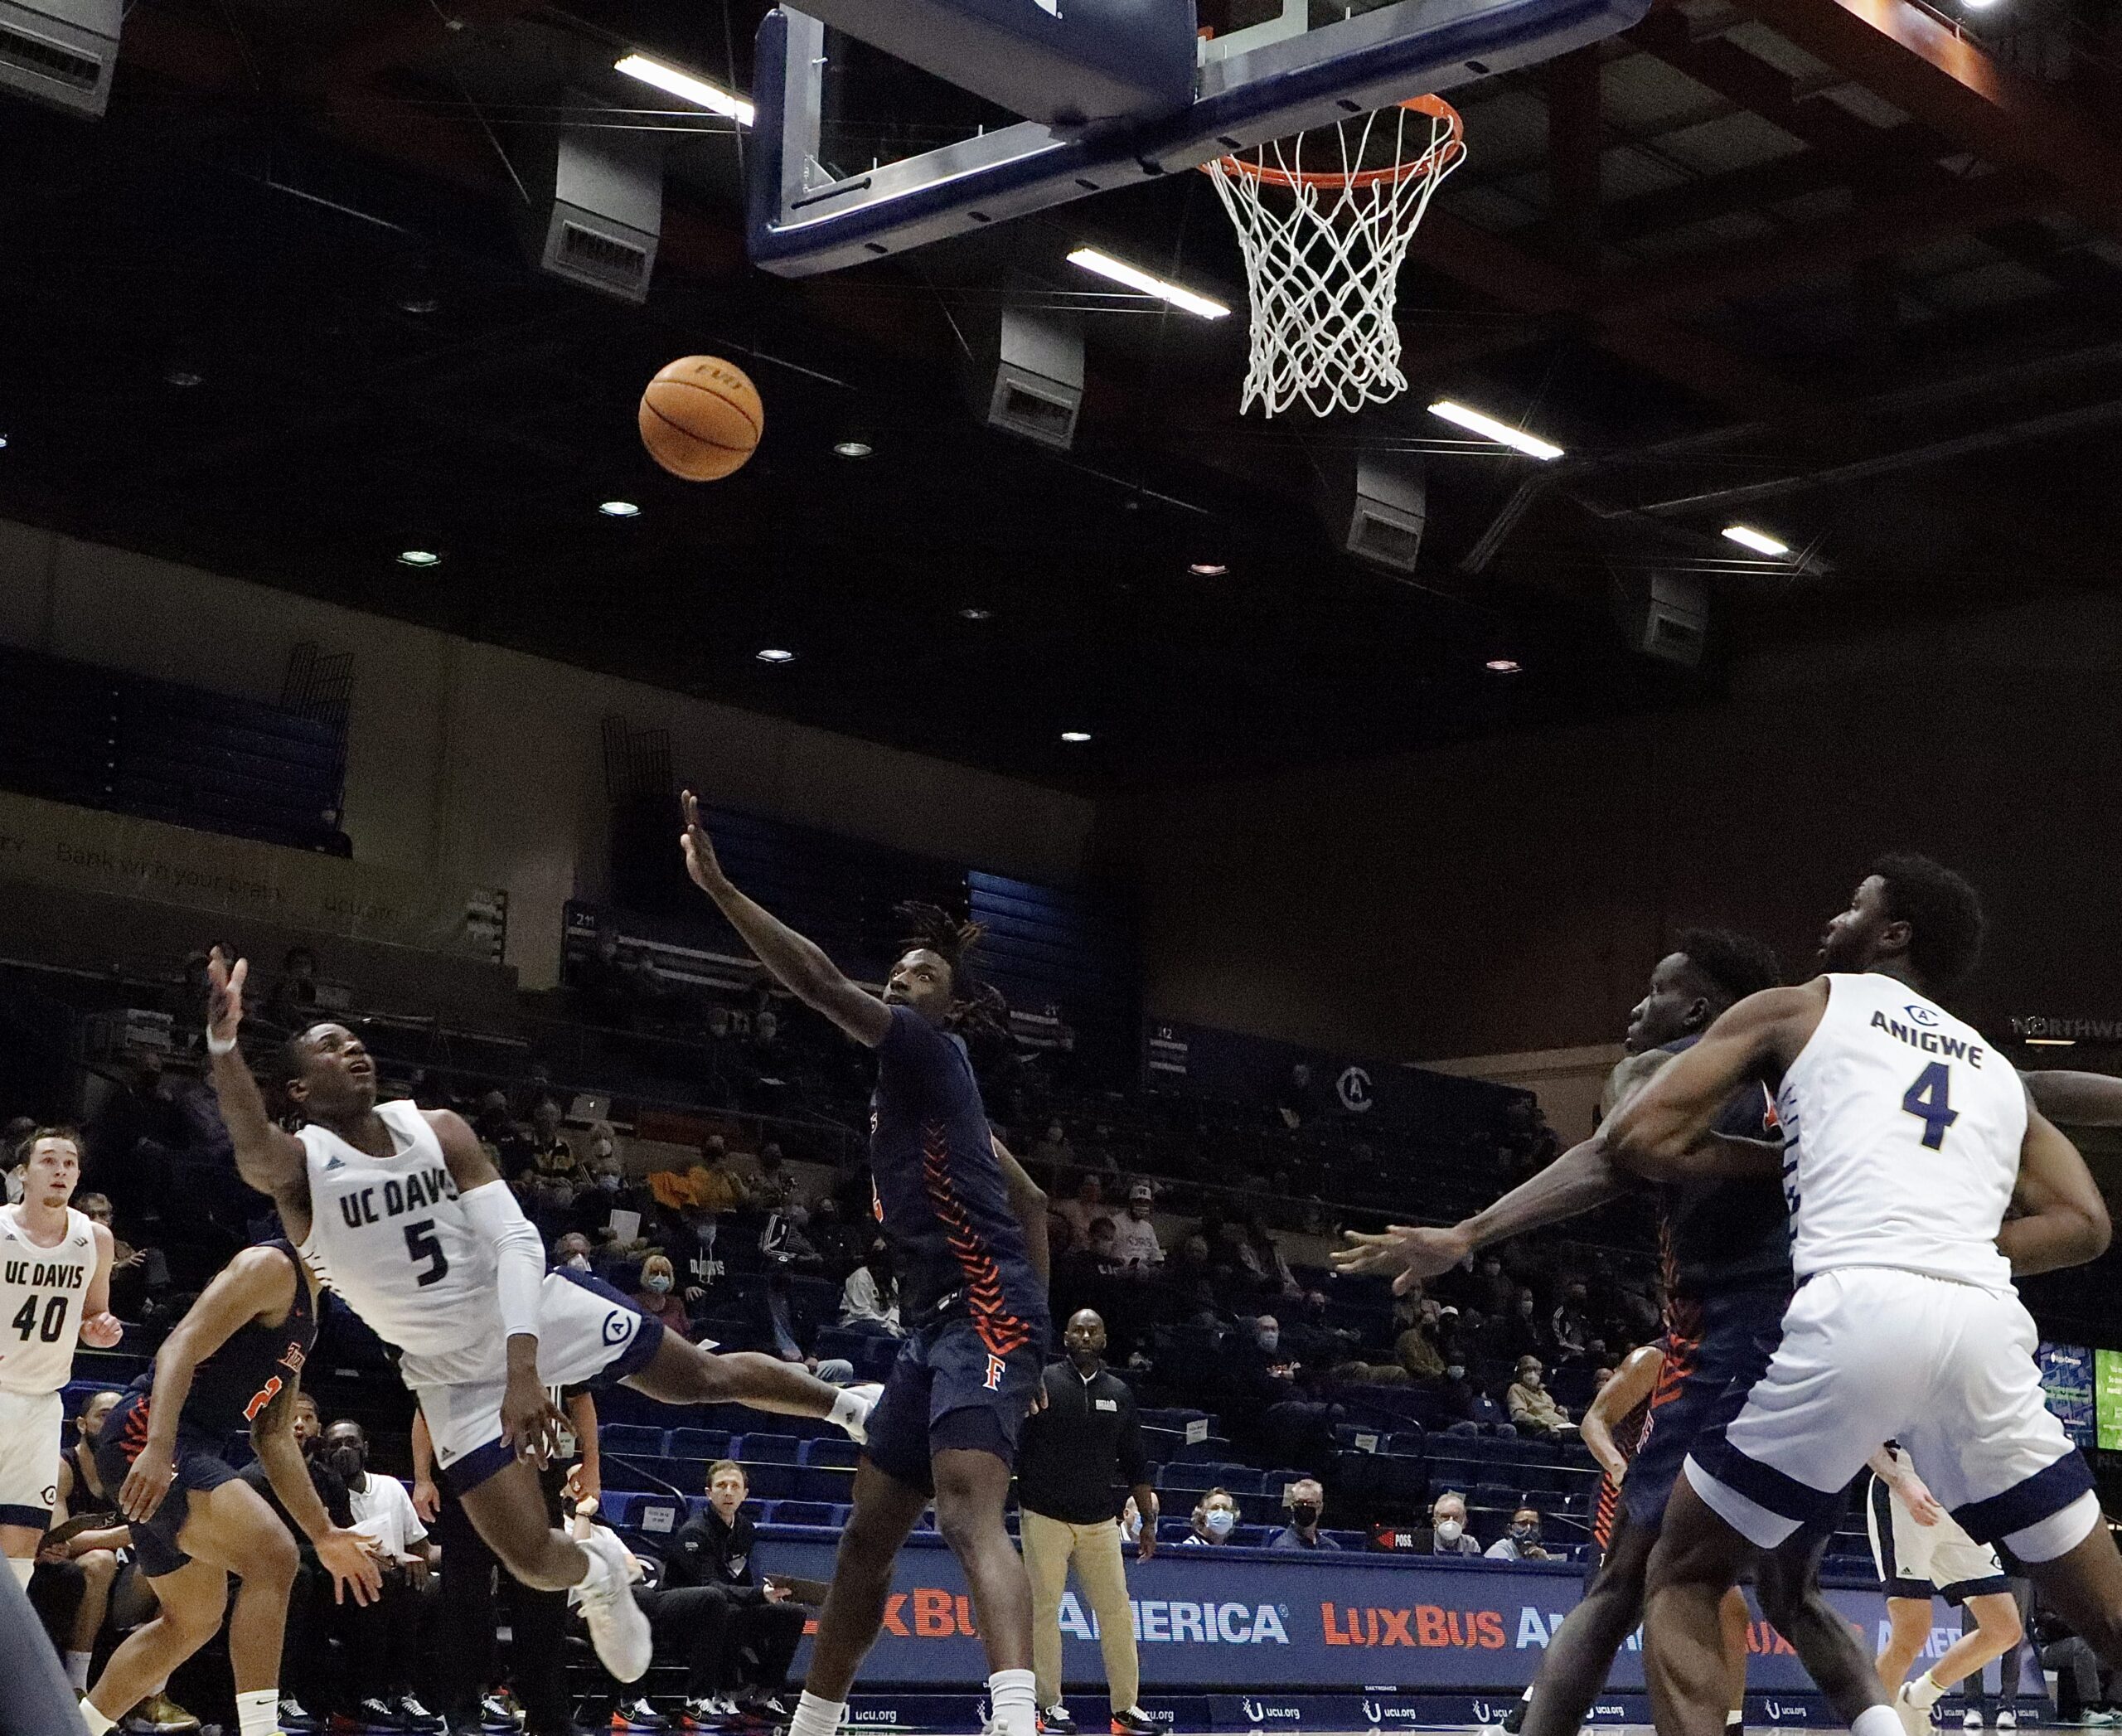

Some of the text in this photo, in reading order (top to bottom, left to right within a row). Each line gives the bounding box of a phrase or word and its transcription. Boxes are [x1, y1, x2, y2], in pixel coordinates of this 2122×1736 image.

[1870, 1010, 1984, 1069] ANIGWE
[1901, 1060, 1960, 1152] 4
[339, 1187, 380, 1228] UC
[403, 1218, 448, 1287] 5
[5, 1261, 85, 1289] UC DAVIS
[12, 1294, 69, 1342] 40
[982, 1353, 1005, 1391] F
[242, 1375, 283, 1422] 2
[1394, 1534, 1413, 1548] POSS.
[855, 1709, 897, 1723] ucu.org
[1146, 1709, 1175, 1723] cu.org
[1266, 1706, 1301, 1719] ucu.org
[1383, 1706, 1416, 1720] ucu.org
[1596, 1705, 1625, 1718] ucu.org
[1781, 1706, 1807, 1719] ucu.org
